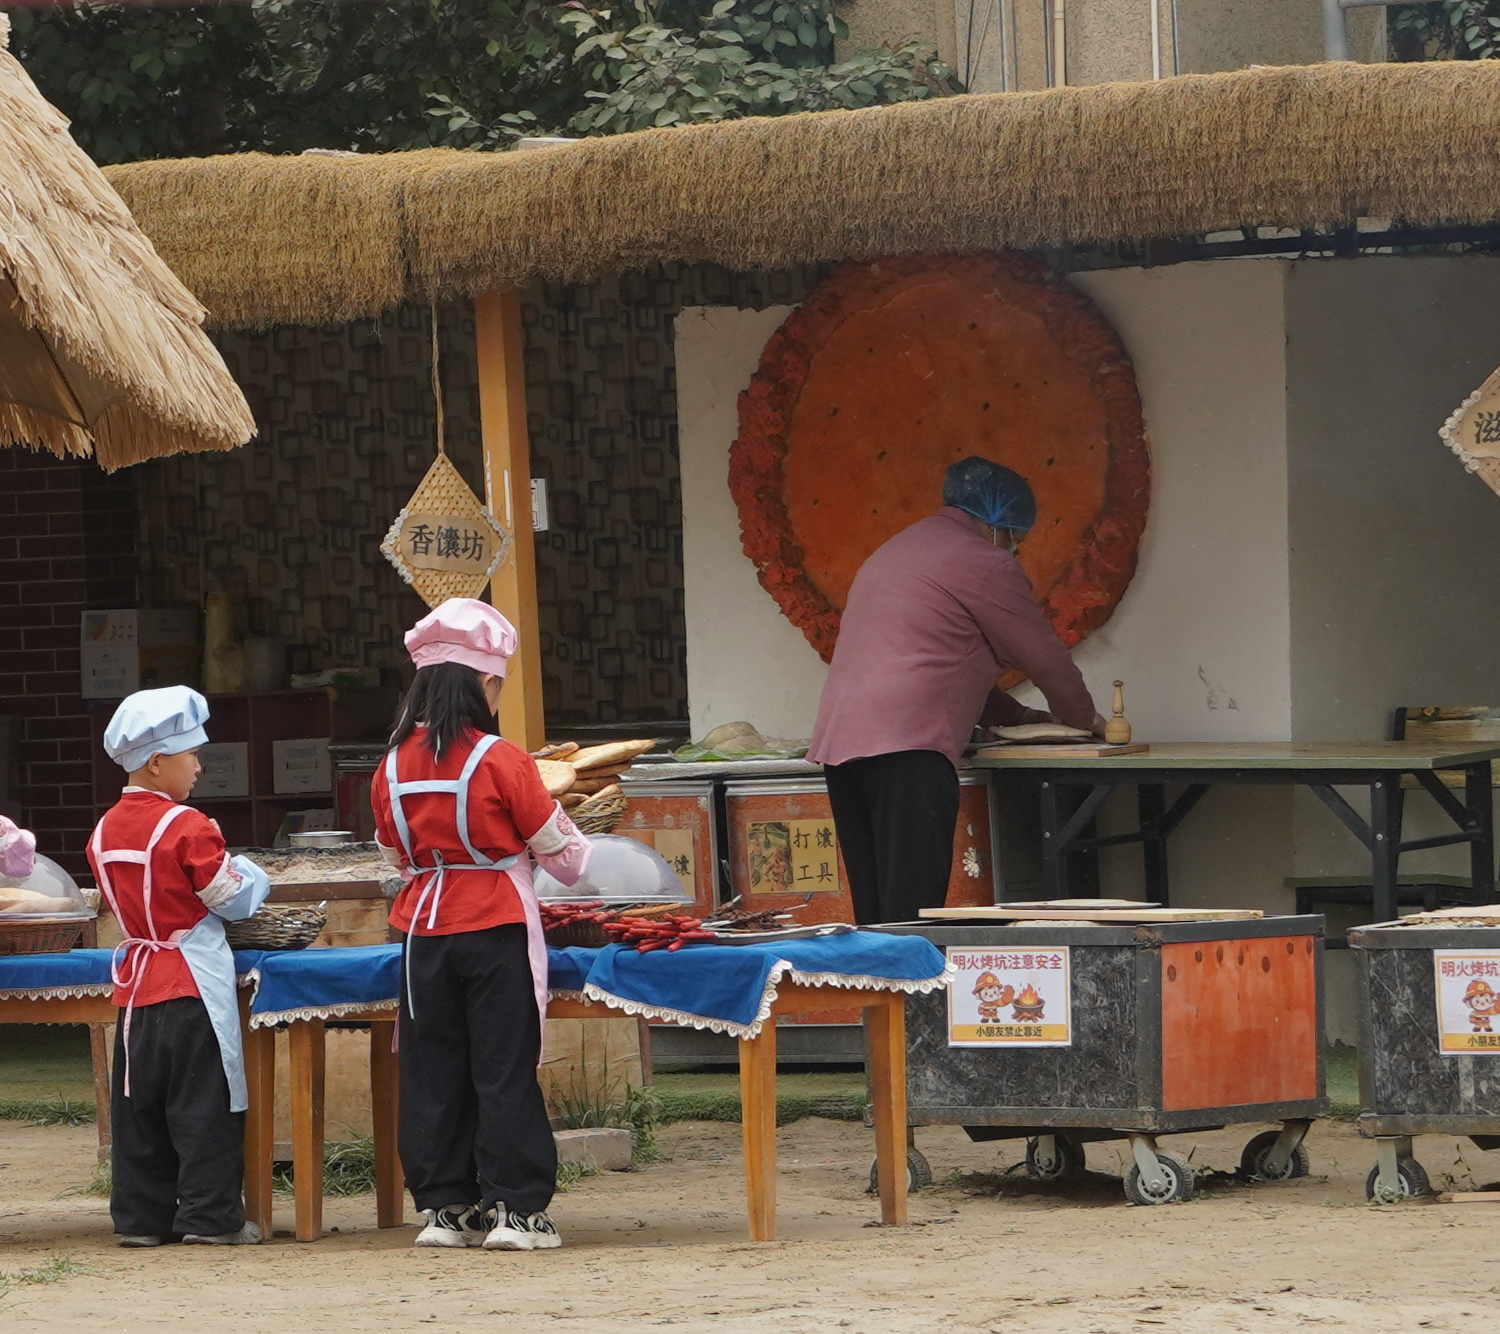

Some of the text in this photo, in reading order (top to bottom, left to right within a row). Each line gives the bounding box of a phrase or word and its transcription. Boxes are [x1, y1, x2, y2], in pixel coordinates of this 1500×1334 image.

[407, 524, 486, 561] 香馕坊
[793, 825, 834, 850] 打馕
[796, 861, 834, 883] 工具
[952, 953, 1063, 971] 明火烤坑注意安全
[975, 1025, 1043, 1038] 小朋友禁止靠近
